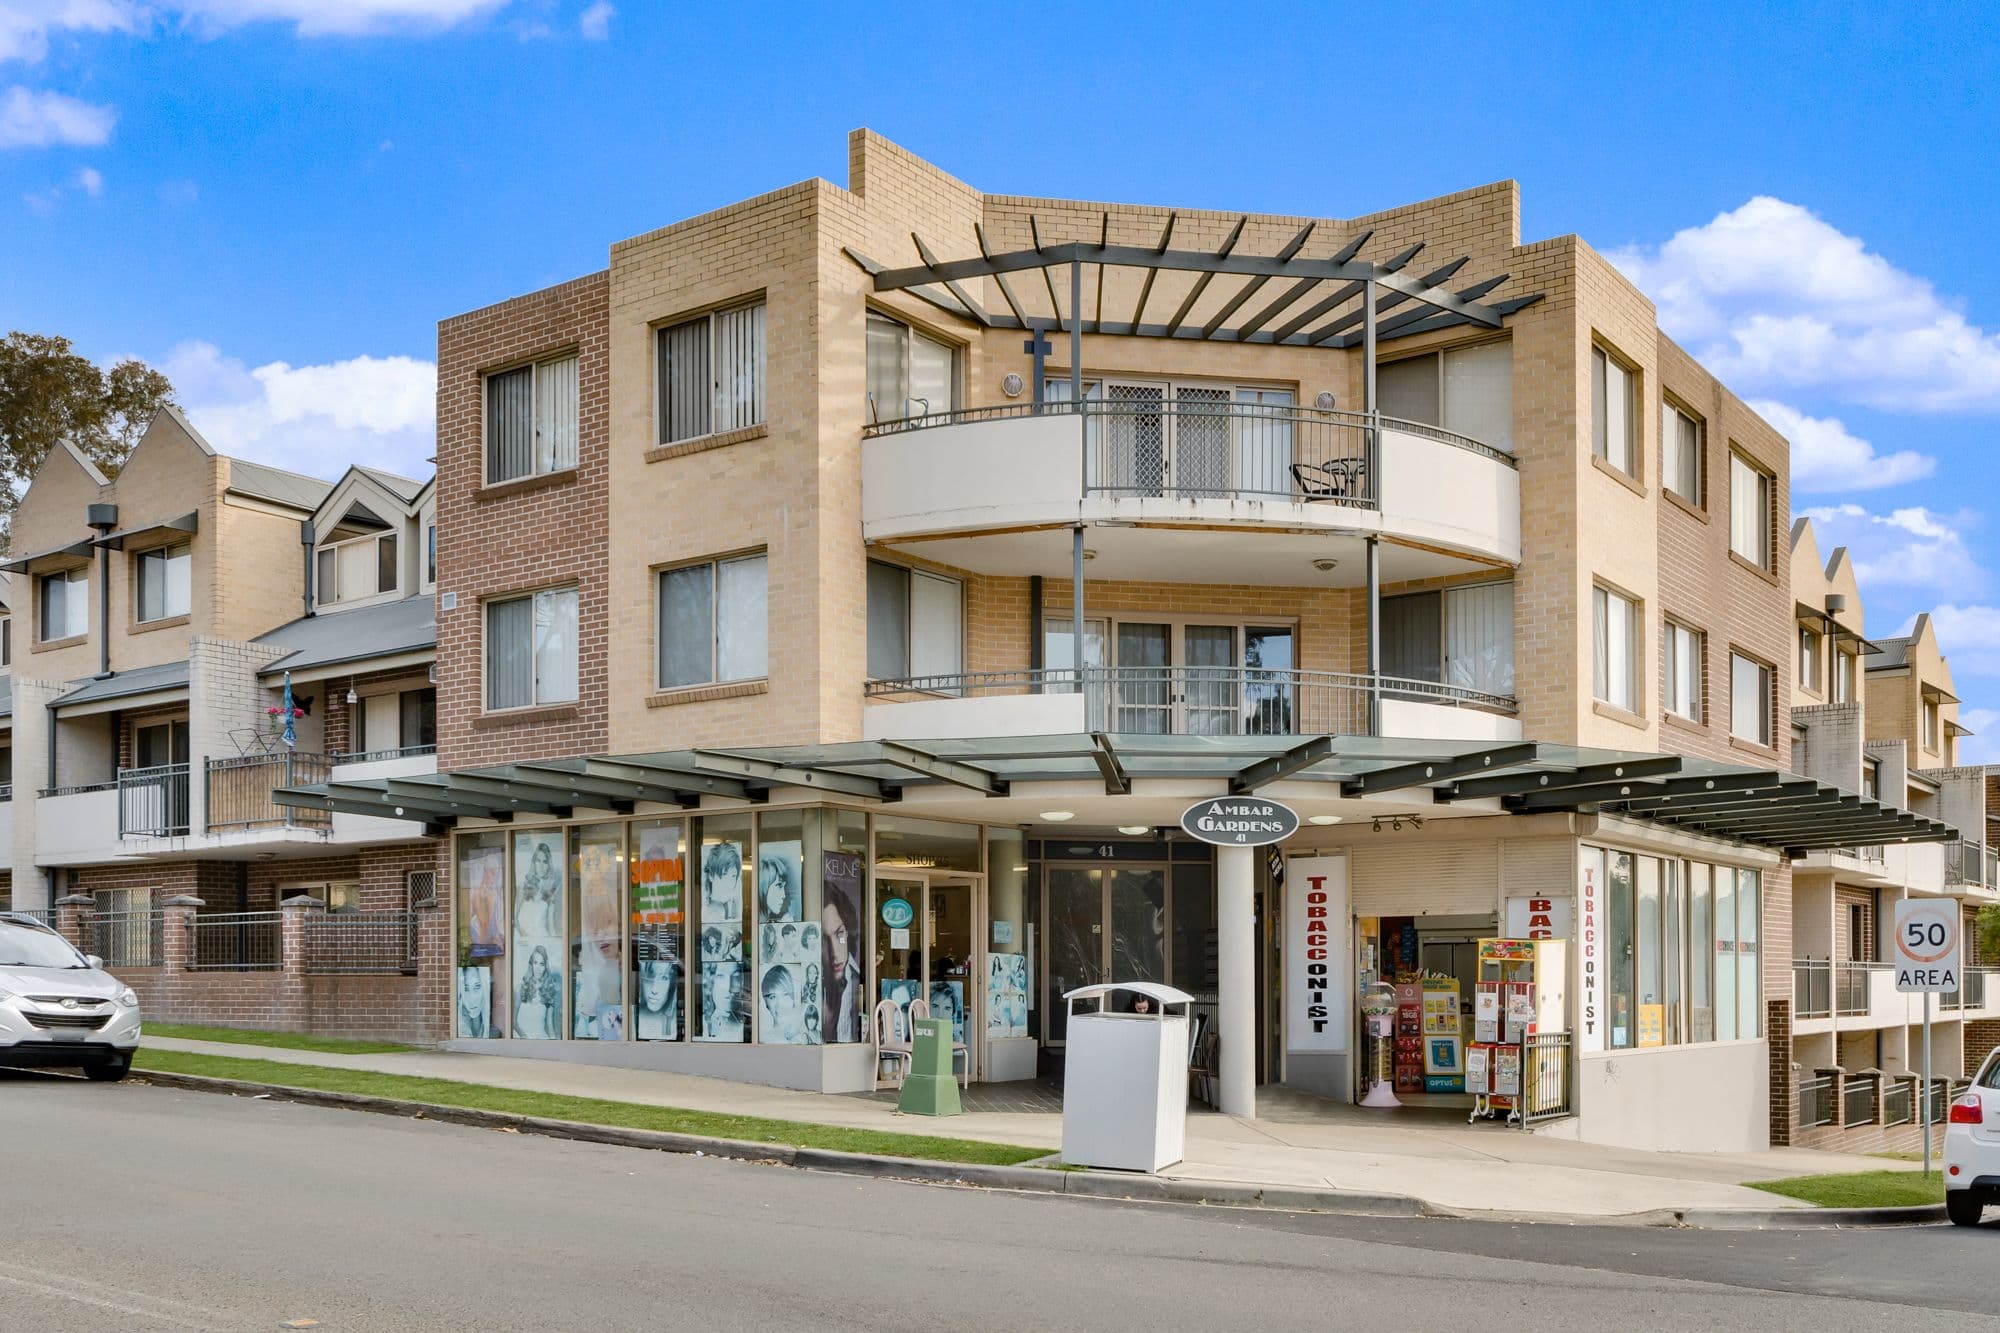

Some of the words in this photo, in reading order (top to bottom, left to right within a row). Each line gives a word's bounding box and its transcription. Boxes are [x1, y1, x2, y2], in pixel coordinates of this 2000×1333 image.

[1207, 801, 1274, 816] AMBAR
[1197, 816, 1284, 833] GARDENS
[1235, 833, 1246, 843] 41
[905, 852, 935, 866] SHOP
[1098, 845, 1114, 857] 41
[824, 857, 860, 878] KEUNE
[1908, 922, 1946, 947] 50
[1306, 876, 1328, 1033] TOBACCONIST
[1584, 868, 1595, 1035] TOBACCONIST
[1898, 969, 1955, 986] AREA
